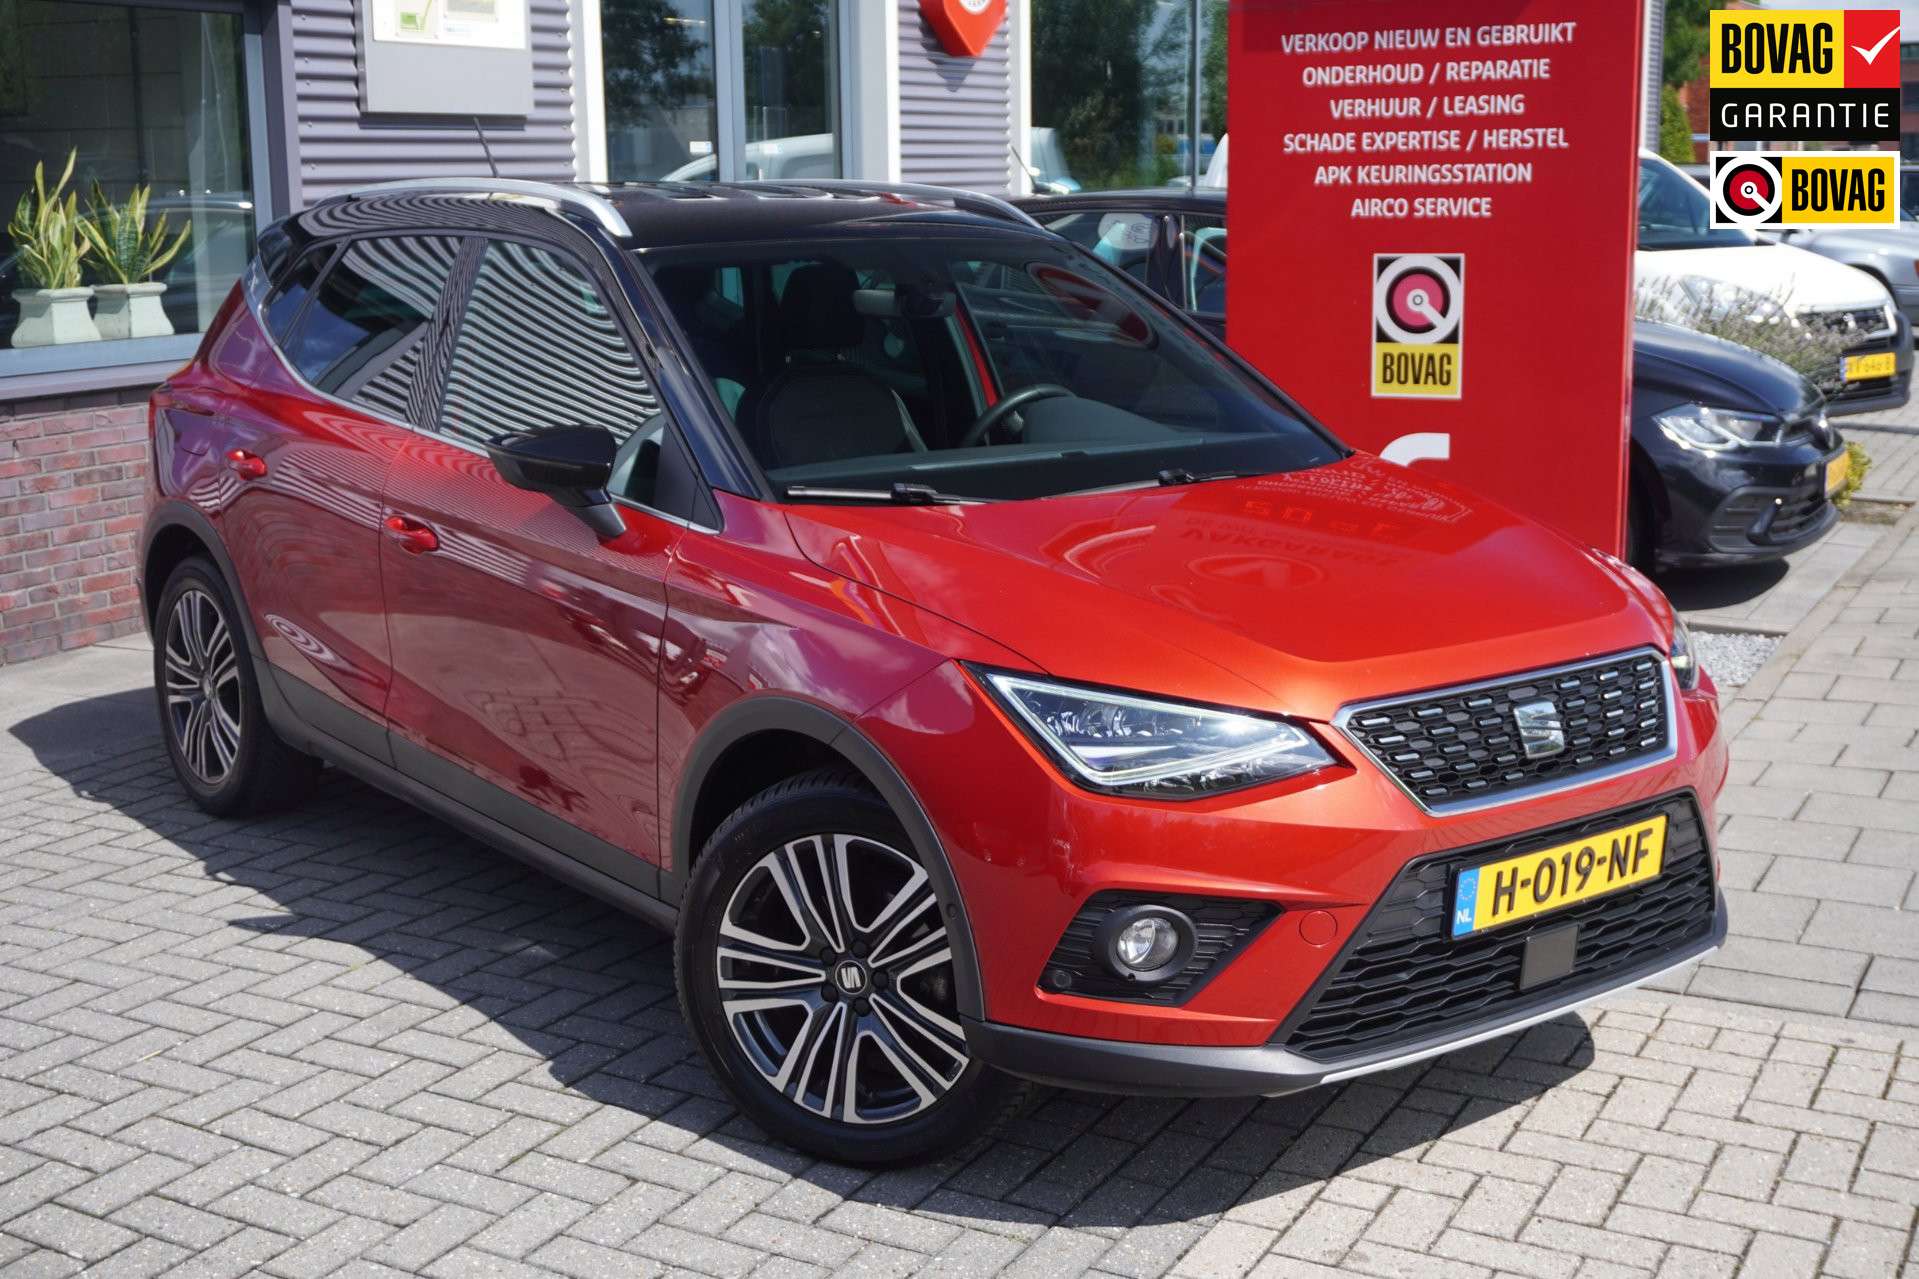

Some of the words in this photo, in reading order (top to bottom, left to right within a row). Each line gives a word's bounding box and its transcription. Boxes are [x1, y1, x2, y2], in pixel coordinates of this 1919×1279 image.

[1282, 32, 1368, 53] VERKOOP
[1375, 29, 1439, 49] NIEUW
[1446, 27, 1470, 47] EN
[1477, 22, 1576, 46] GEBRUIKT
[1303, 63, 1424, 86] ONDERHOUD
[1446, 59, 1550, 81] REPARATIE
[1330, 97, 1421, 118] VERHUUR
[1444, 94, 1524, 116] LEASING
[1284, 133, 1355, 153] SCHADE
[1362, 130, 1460, 151] EXPERTISE
[1483, 128, 1568, 149] HERSTEL
[1315, 166, 1352, 184] APK
[1357, 163, 1532, 184] KEURINGSSTATION
[1351, 198, 1408, 217] AIRCO
[1414, 197, 1491, 217] SERVICE
[1382, 352, 1452, 386] BOVAG
[1492, 828, 1653, 917] H-019-NF
[1456, 908, 1472, 924] NL
